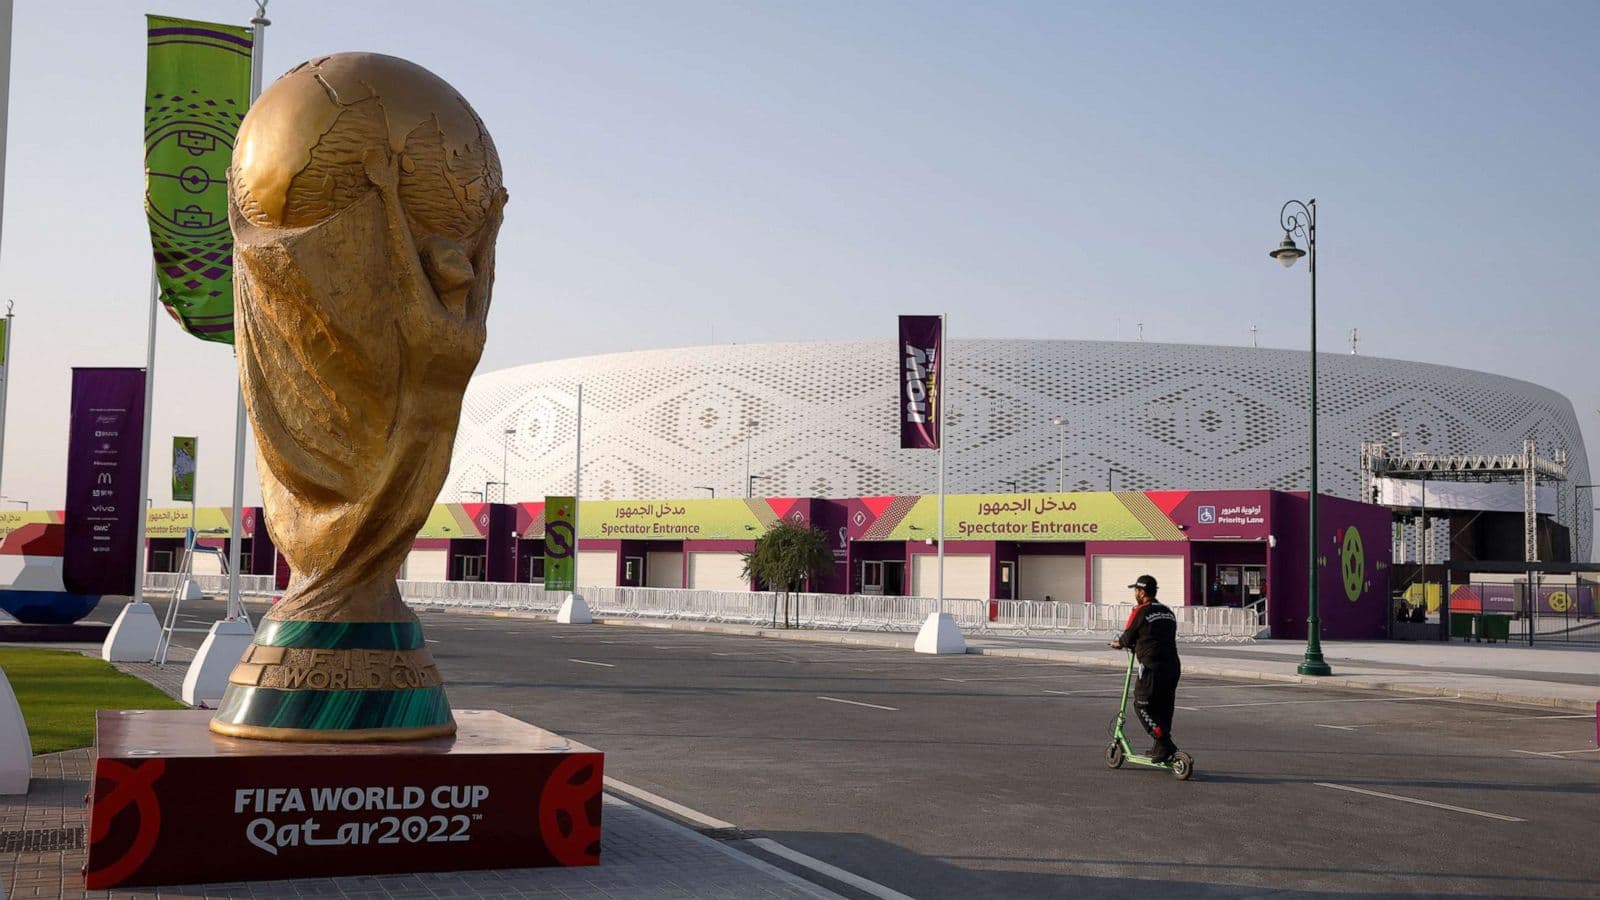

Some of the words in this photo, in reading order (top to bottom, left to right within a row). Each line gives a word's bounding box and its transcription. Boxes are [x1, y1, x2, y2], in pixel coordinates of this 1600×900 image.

[615, 504, 654, 519] الجمهور
[656, 503, 686, 518] مدخل
[977, 498, 1031, 515] الجمهور
[1035, 496, 1077, 515] مدخل
[1218, 516, 1246, 525] Priority
[146, 526, 169, 534] ectator
[169, 525, 187, 534] Entra
[601, 523, 651, 536] Spectator
[653, 523, 700, 534] Entrance
[958, 521, 1028, 536] Spectator
[1031, 521, 1098, 533] Entrance
[309, 650, 412, 670] FIFA
[284, 667, 383, 690] WORLD
[390, 669, 432, 688] CUP
[234, 788, 306, 813] FIFA
[310, 786, 426, 812] WORLD
[430, 785, 490, 809] CUP
